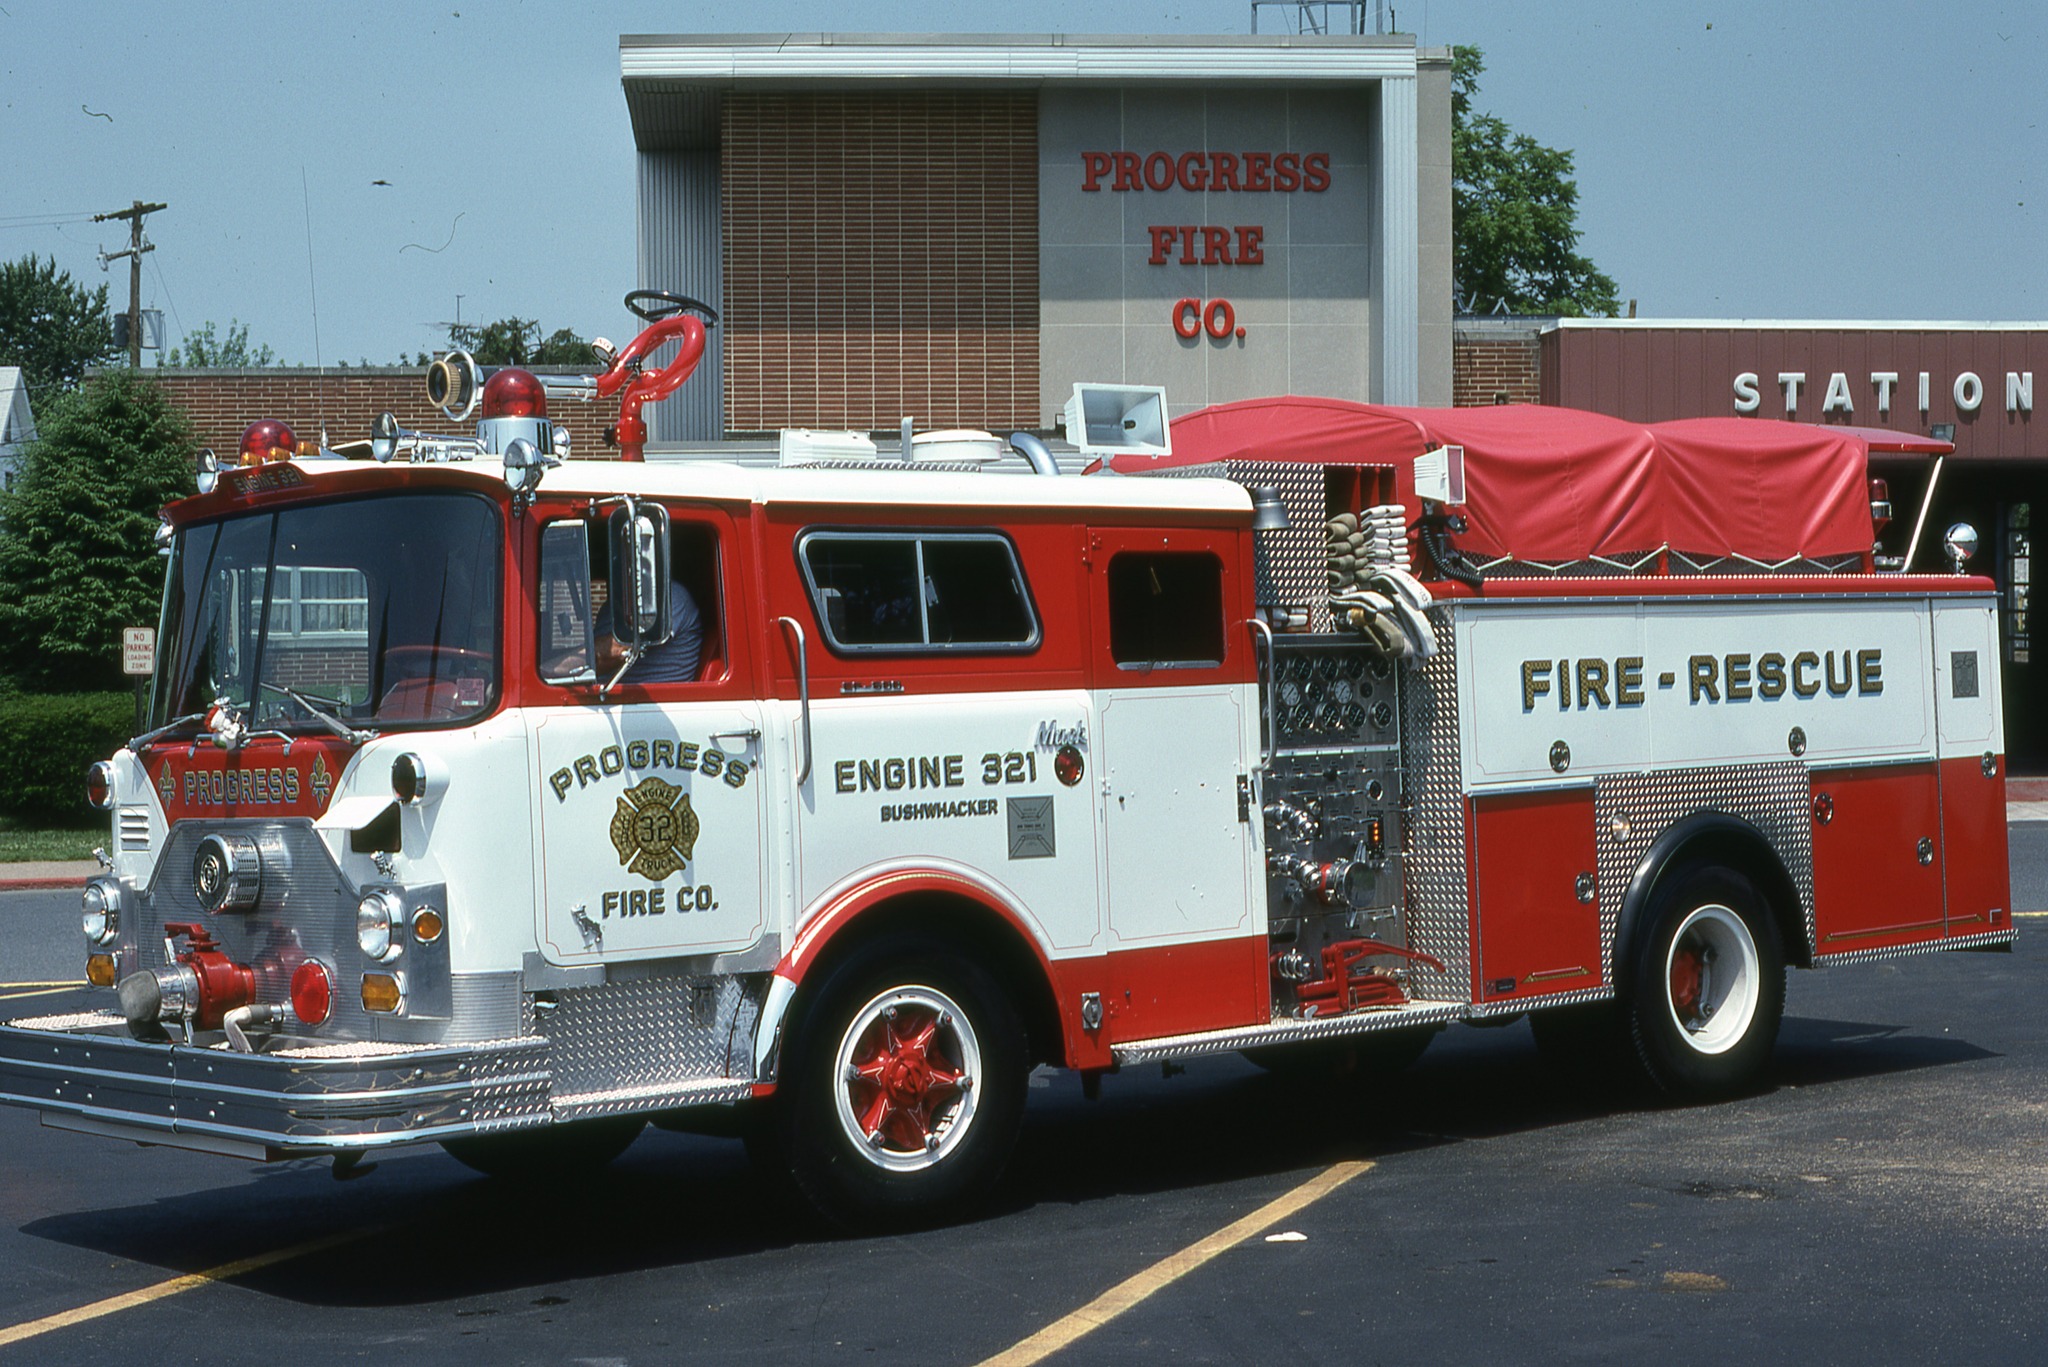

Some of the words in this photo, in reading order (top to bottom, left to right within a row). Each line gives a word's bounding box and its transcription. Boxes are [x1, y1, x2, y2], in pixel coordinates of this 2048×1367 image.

[1081, 151, 1331, 192] PROGRESS
[1148, 226, 1264, 265] FIRE
[1172, 298, 1246, 338] CO.
[1733, 372, 2034, 412] STATION
[233, 471, 279, 494] ENGINE
[278, 467, 303, 486] 321
[133, 633, 145, 641] NO
[1520, 656, 1646, 713] FIRE
[1687, 648, 1884, 706] RESCUE
[184, 767, 300, 805] PROGRESS
[550, 738, 749, 803] PROGRESS
[835, 754, 965, 793] ENGINE
[981, 750, 1037, 786] 321
[634, 787, 672, 802] ENGINE
[881, 798, 998, 822] BUSHWHACKER
[640, 815, 672, 842] 32
[641, 856, 676, 870] TRUCK
[602, 887, 666, 918] FIRE
[676, 884, 719, 913] CO.
